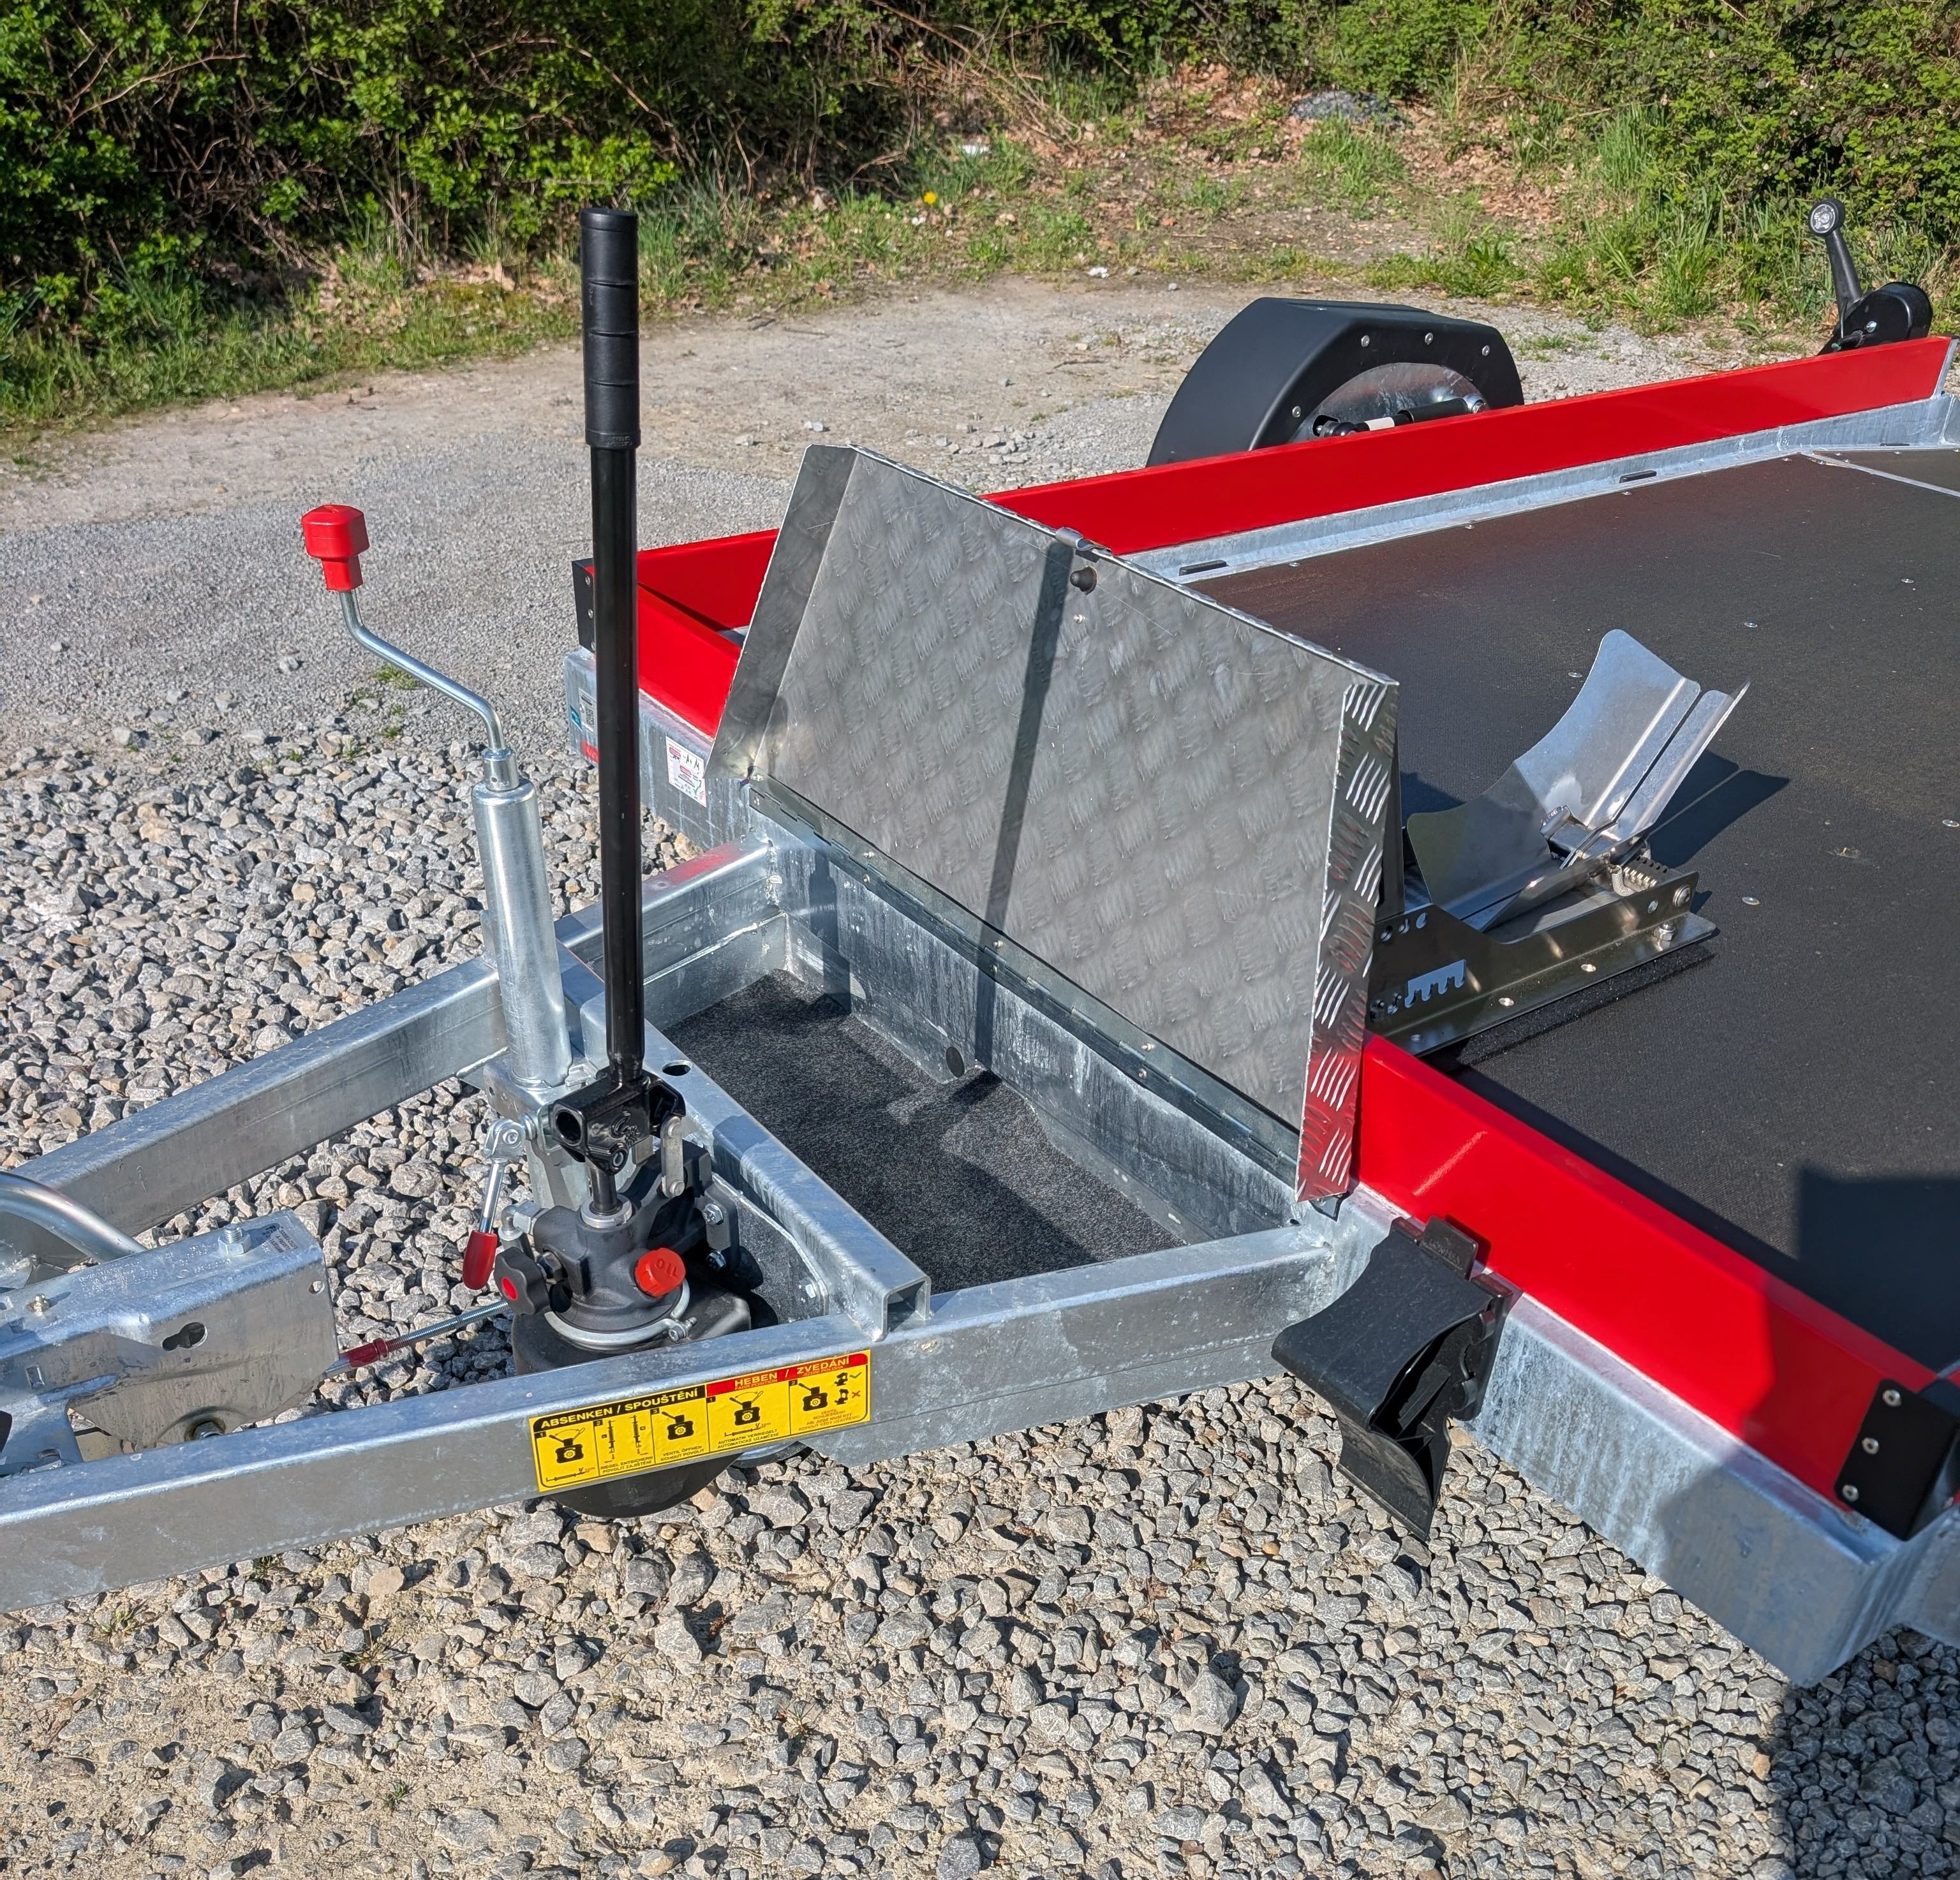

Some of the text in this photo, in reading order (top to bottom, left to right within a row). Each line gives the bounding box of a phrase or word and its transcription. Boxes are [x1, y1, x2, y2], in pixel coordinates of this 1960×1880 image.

[654, 1258, 679, 1279] OIL
[734, 1372, 778, 1388] HEBEN
[796, 1356, 849, 1374] ZVEDÁNÍ
[540, 1407, 612, 1428] ABSENKEN
[623, 1388, 698, 1411] SPOUŠTĚNÍ
